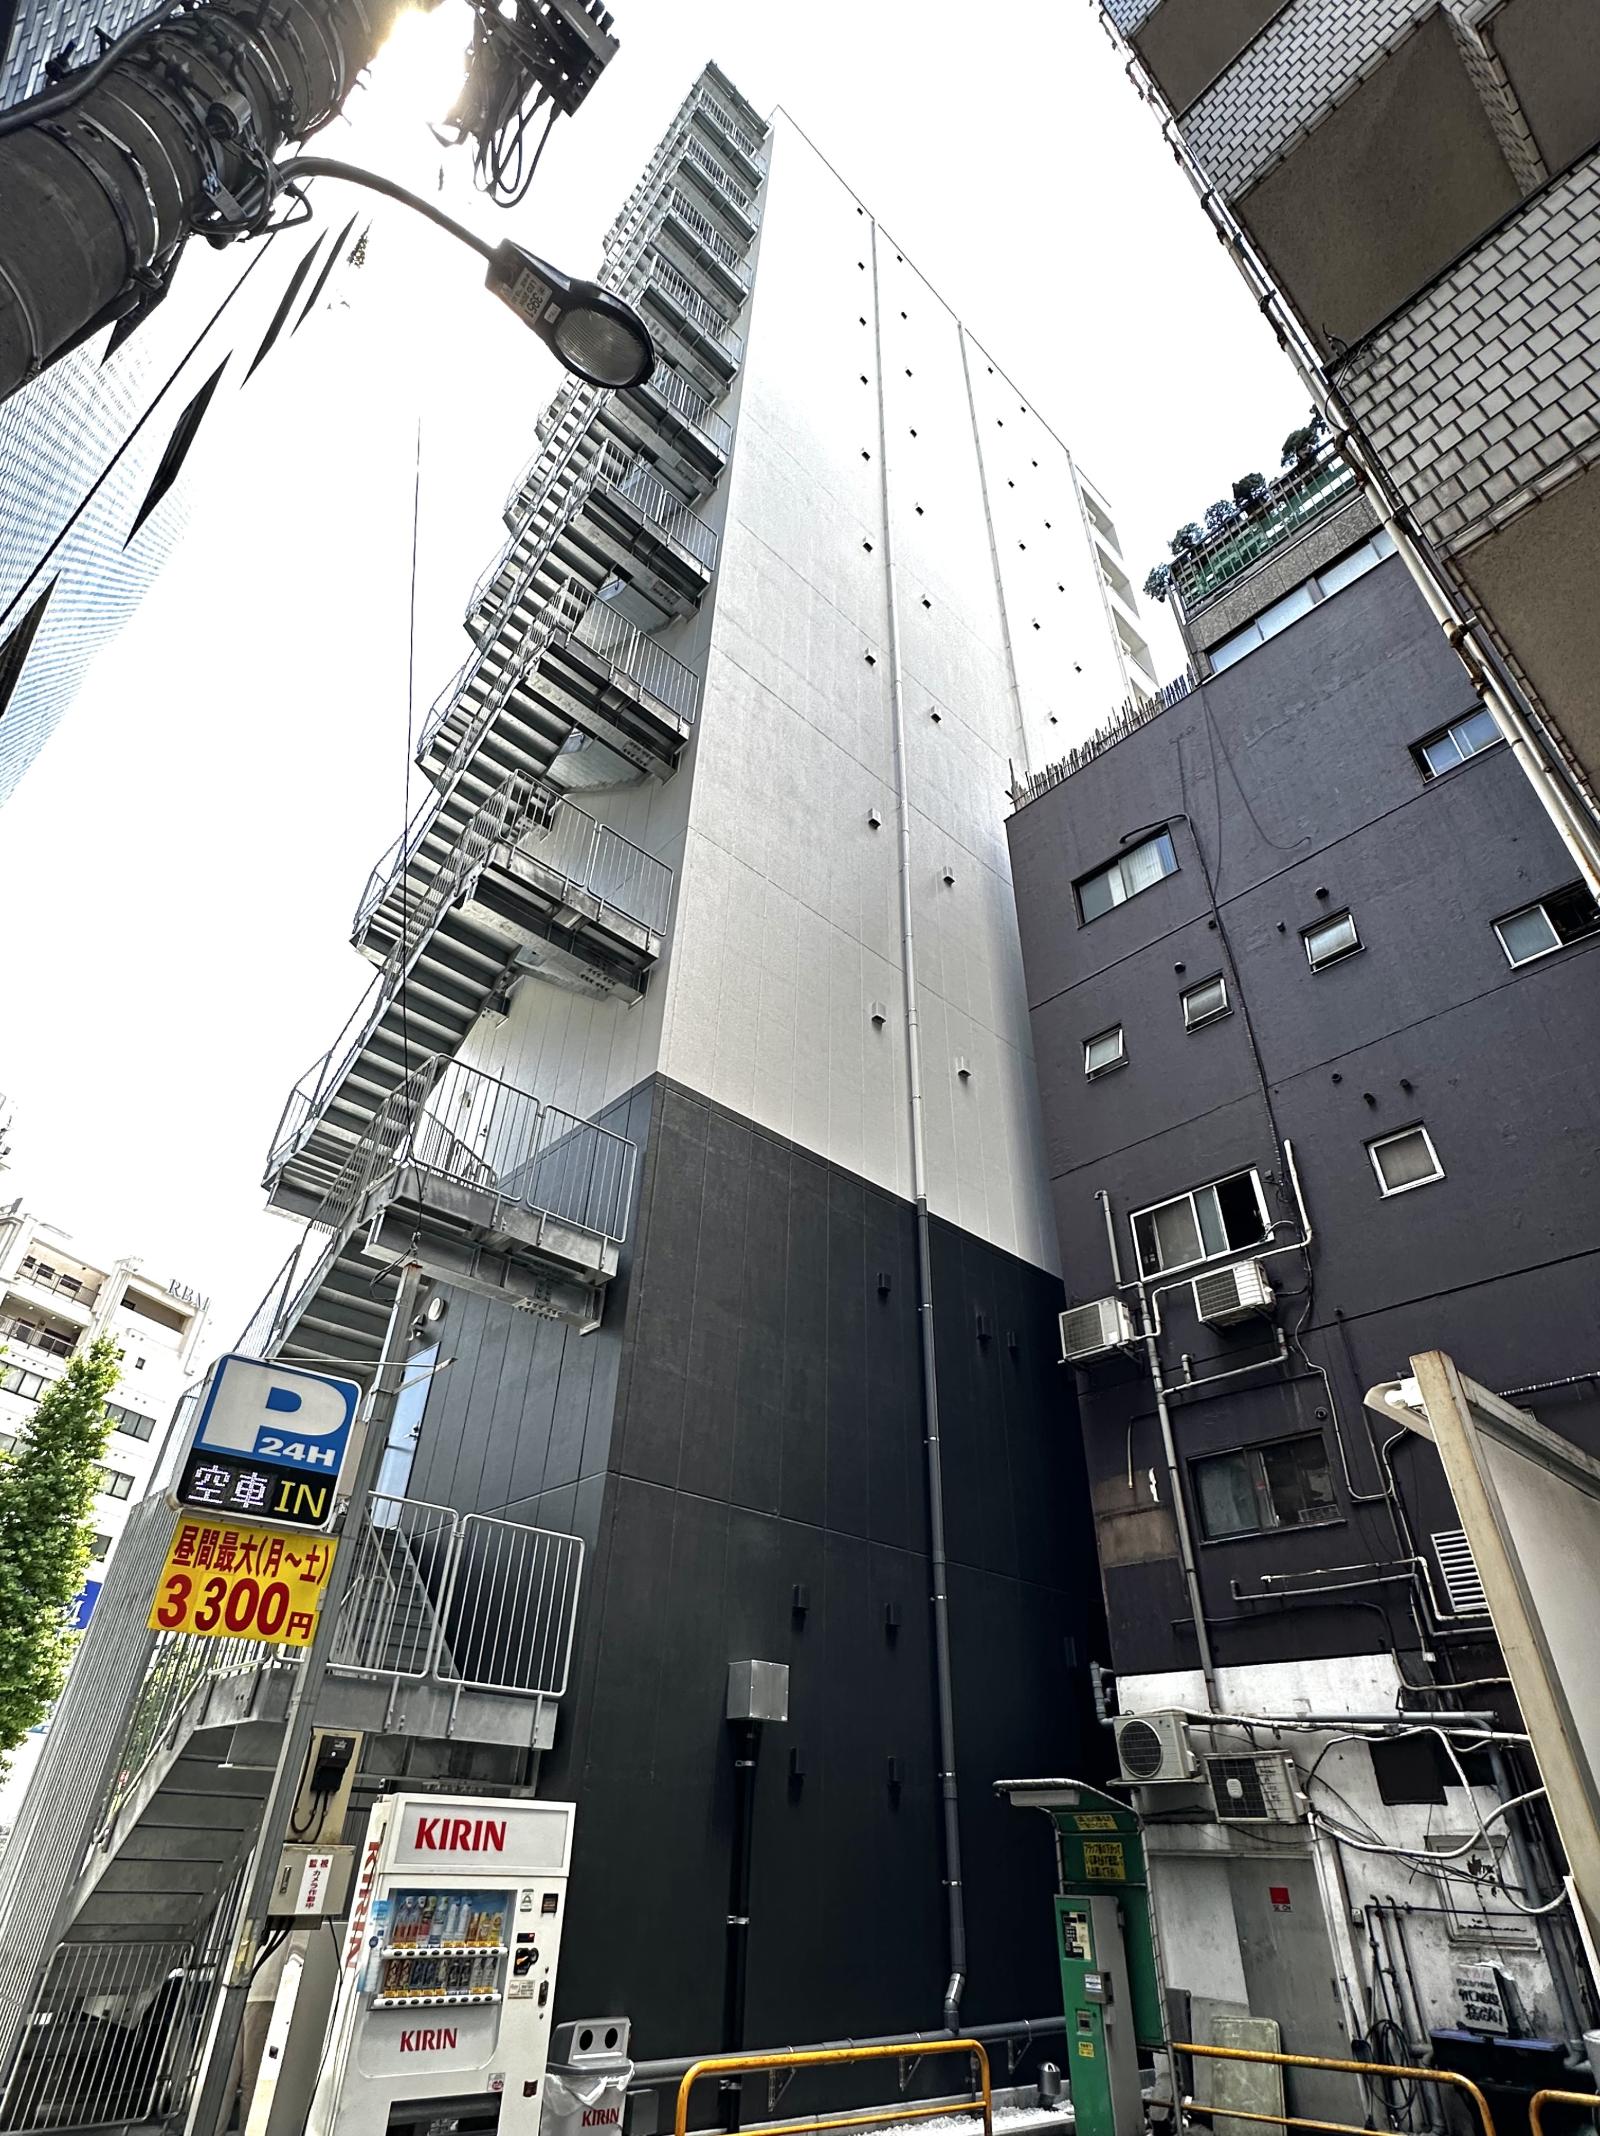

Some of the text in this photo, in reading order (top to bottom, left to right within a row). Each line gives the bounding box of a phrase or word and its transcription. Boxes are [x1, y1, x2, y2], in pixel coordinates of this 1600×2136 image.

[201, 1358, 347, 1453] P
[258, 1437, 336, 1467] 24H
[188, 1464, 327, 1518] 空車 IN
[414, 1817, 507, 1852] KIRIN
[345, 1841, 380, 1969] KIRIN
[400, 2028, 458, 2052] KIRIN
[581, 2107, 620, 2127] KIRIN
